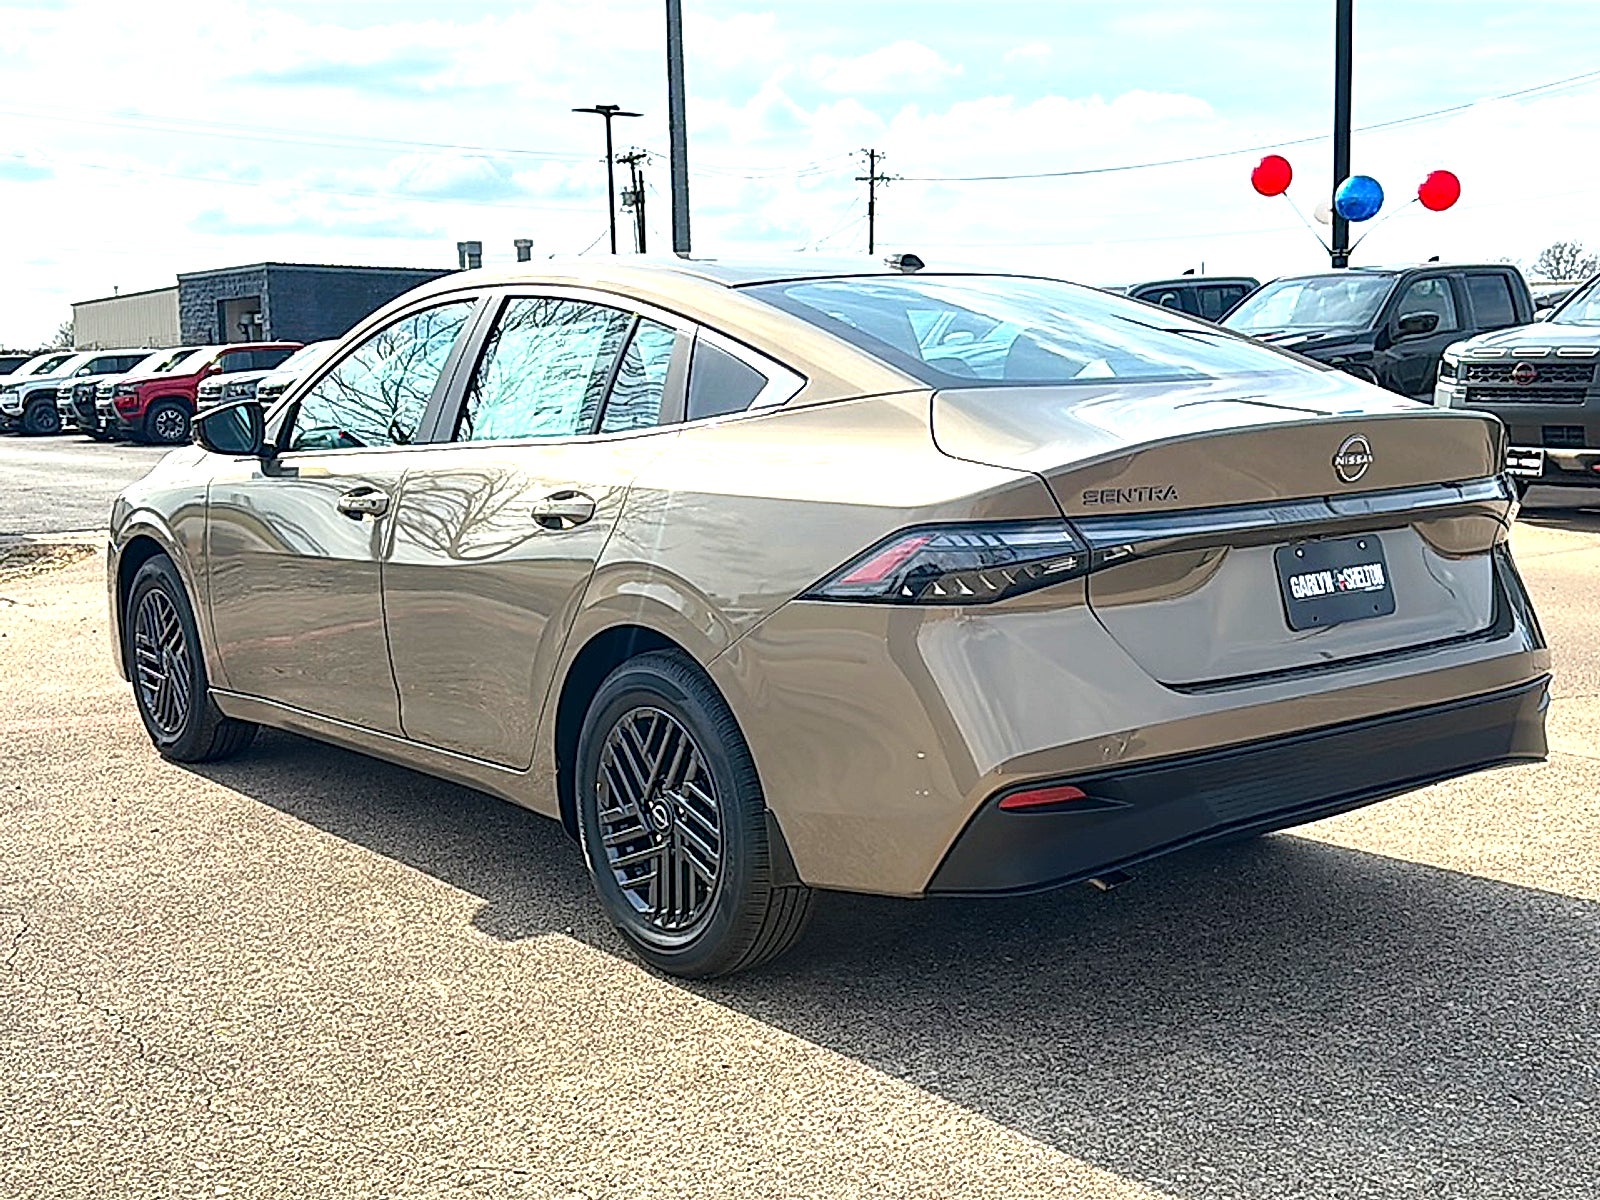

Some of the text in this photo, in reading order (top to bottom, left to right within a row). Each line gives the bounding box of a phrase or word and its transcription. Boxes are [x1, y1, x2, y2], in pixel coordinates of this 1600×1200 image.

[1335, 454, 1373, 465] NISSAN
[1083, 485, 1178, 505] SENTRA
[1342, 563, 1385, 589] SHELTON
